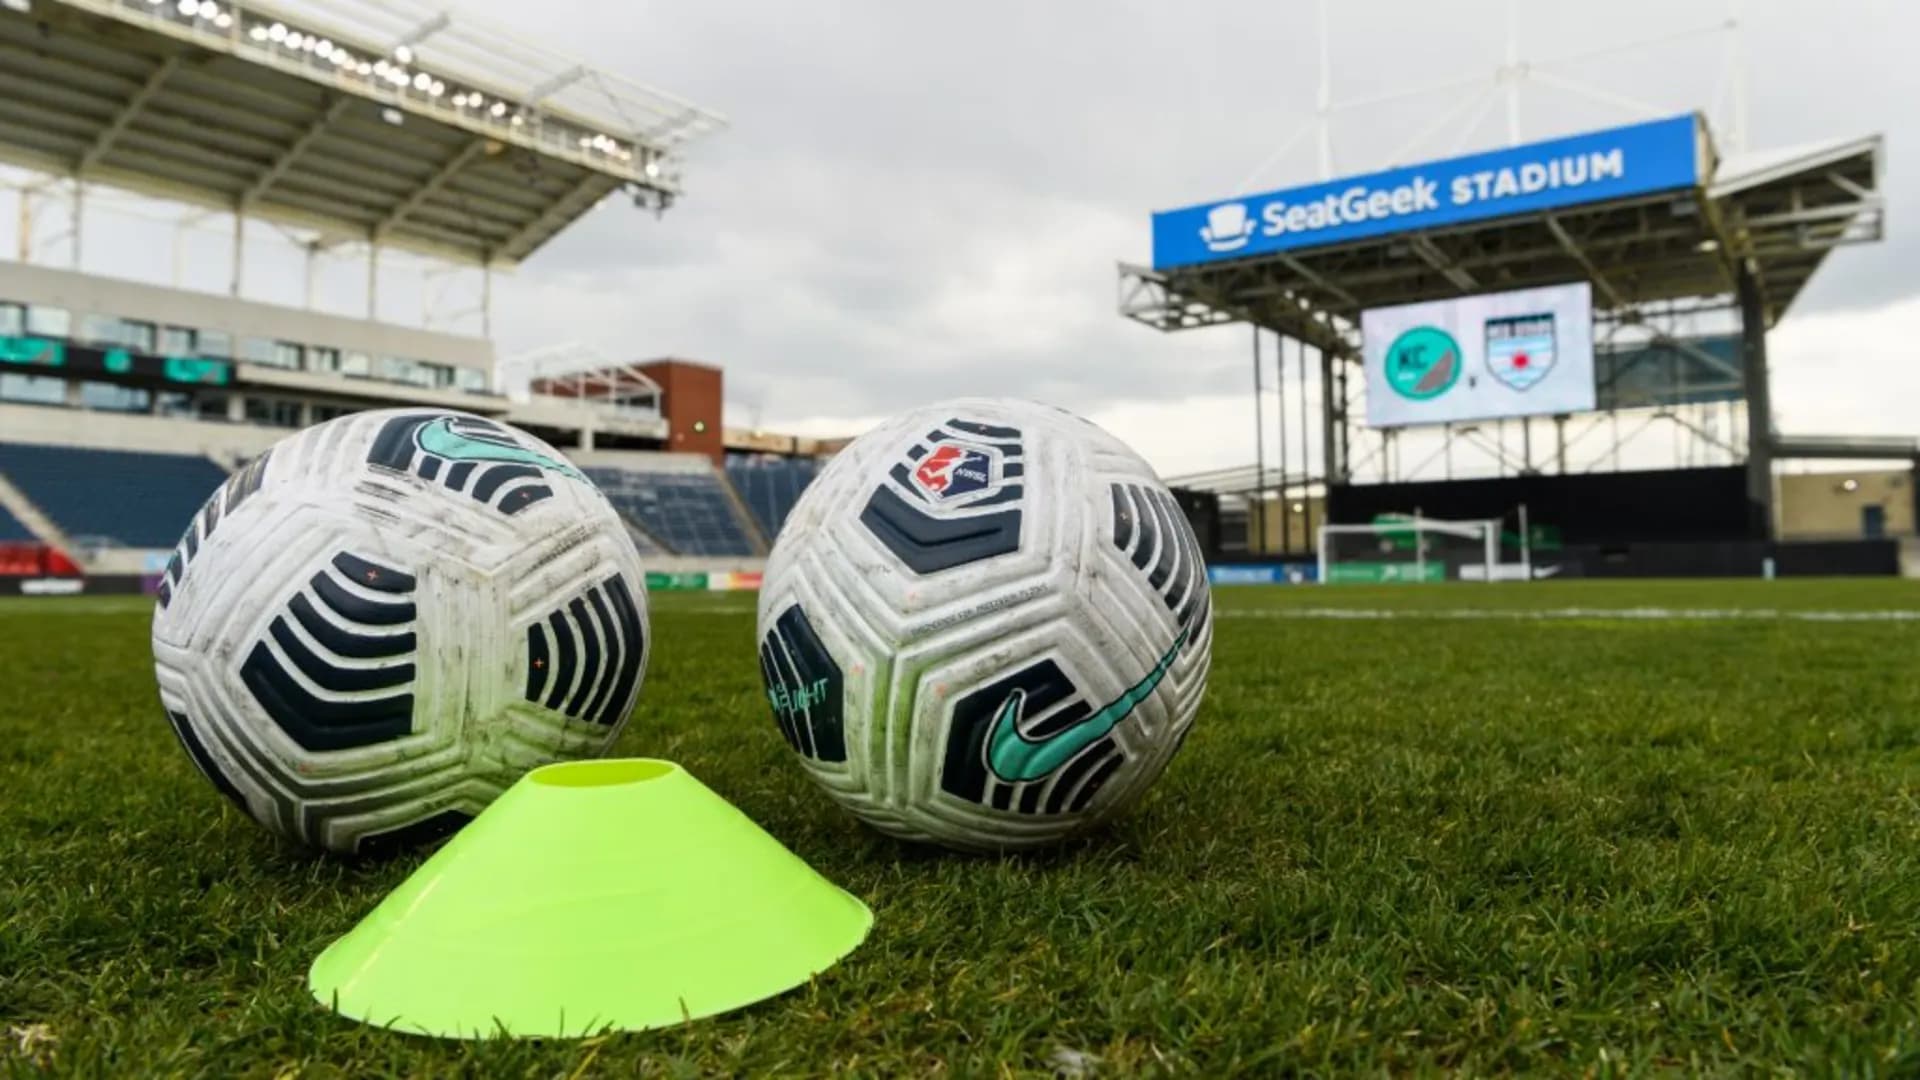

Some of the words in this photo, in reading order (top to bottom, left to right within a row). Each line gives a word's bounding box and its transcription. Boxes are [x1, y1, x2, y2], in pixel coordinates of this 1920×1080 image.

[1262, 175, 1438, 236] SeatGeek
[1451, 148, 1623, 205] STADIUM
[1398, 345, 1429, 370] KC
